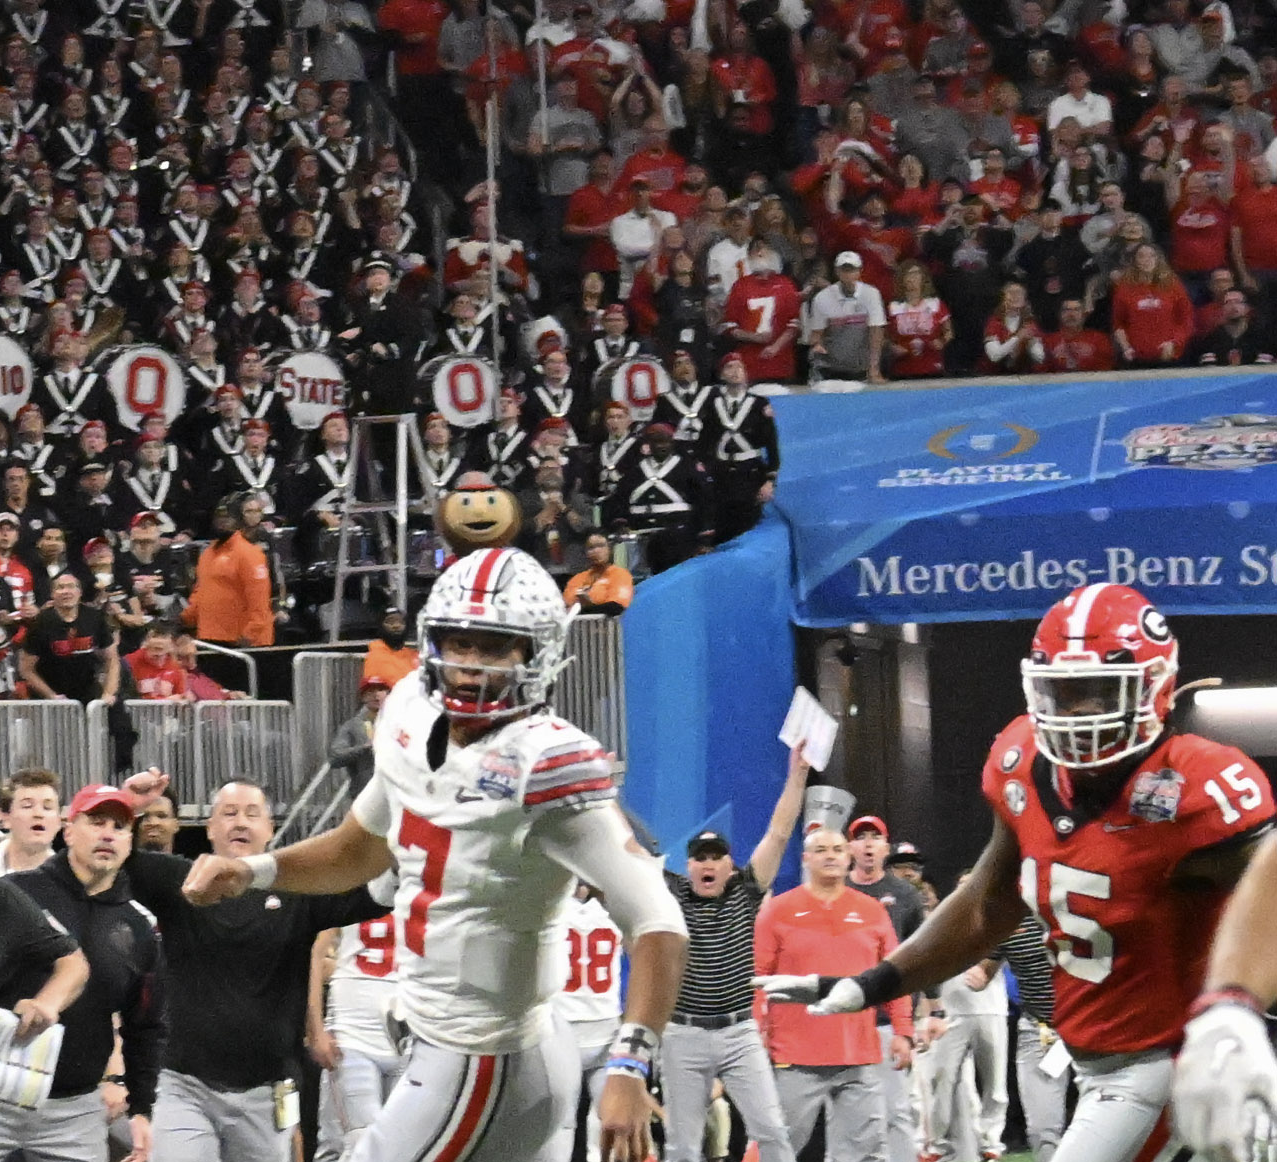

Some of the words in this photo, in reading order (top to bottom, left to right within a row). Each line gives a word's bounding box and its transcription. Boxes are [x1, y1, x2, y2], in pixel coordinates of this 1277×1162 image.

[747, 296, 776, 334] 7
[126, 356, 167, 414] O
[447, 363, 485, 412] O
[857, 547, 1222, 597] Mercedes-Benz
[1204, 763, 1262, 824] 15
[398, 808, 453, 958] 7
[1019, 856, 1114, 984] 15
